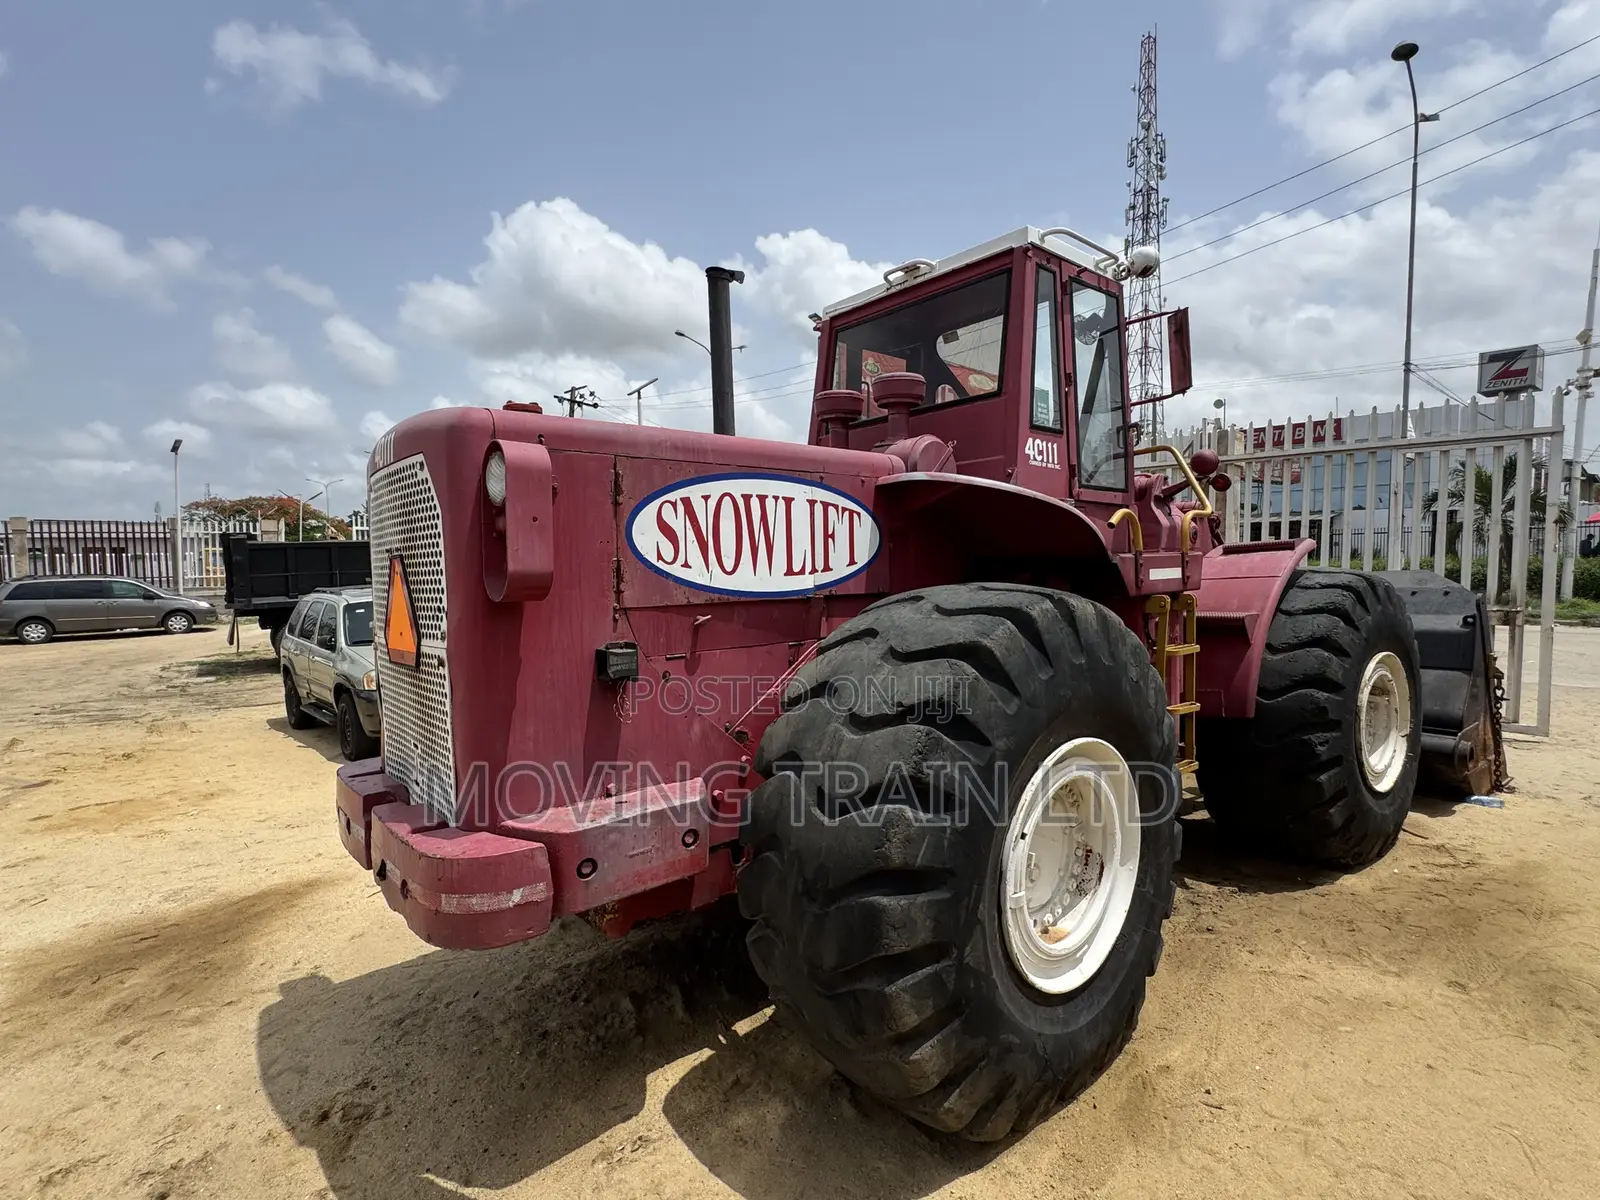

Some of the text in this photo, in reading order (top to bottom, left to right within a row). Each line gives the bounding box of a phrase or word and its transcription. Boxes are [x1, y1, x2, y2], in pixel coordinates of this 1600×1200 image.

[1485, 377, 1528, 389] ZENITH
[1242, 423, 1337, 445] ENT BN
[1025, 437, 1058, 464] 4C111
[656, 492, 861, 577] SNOWLIFT
